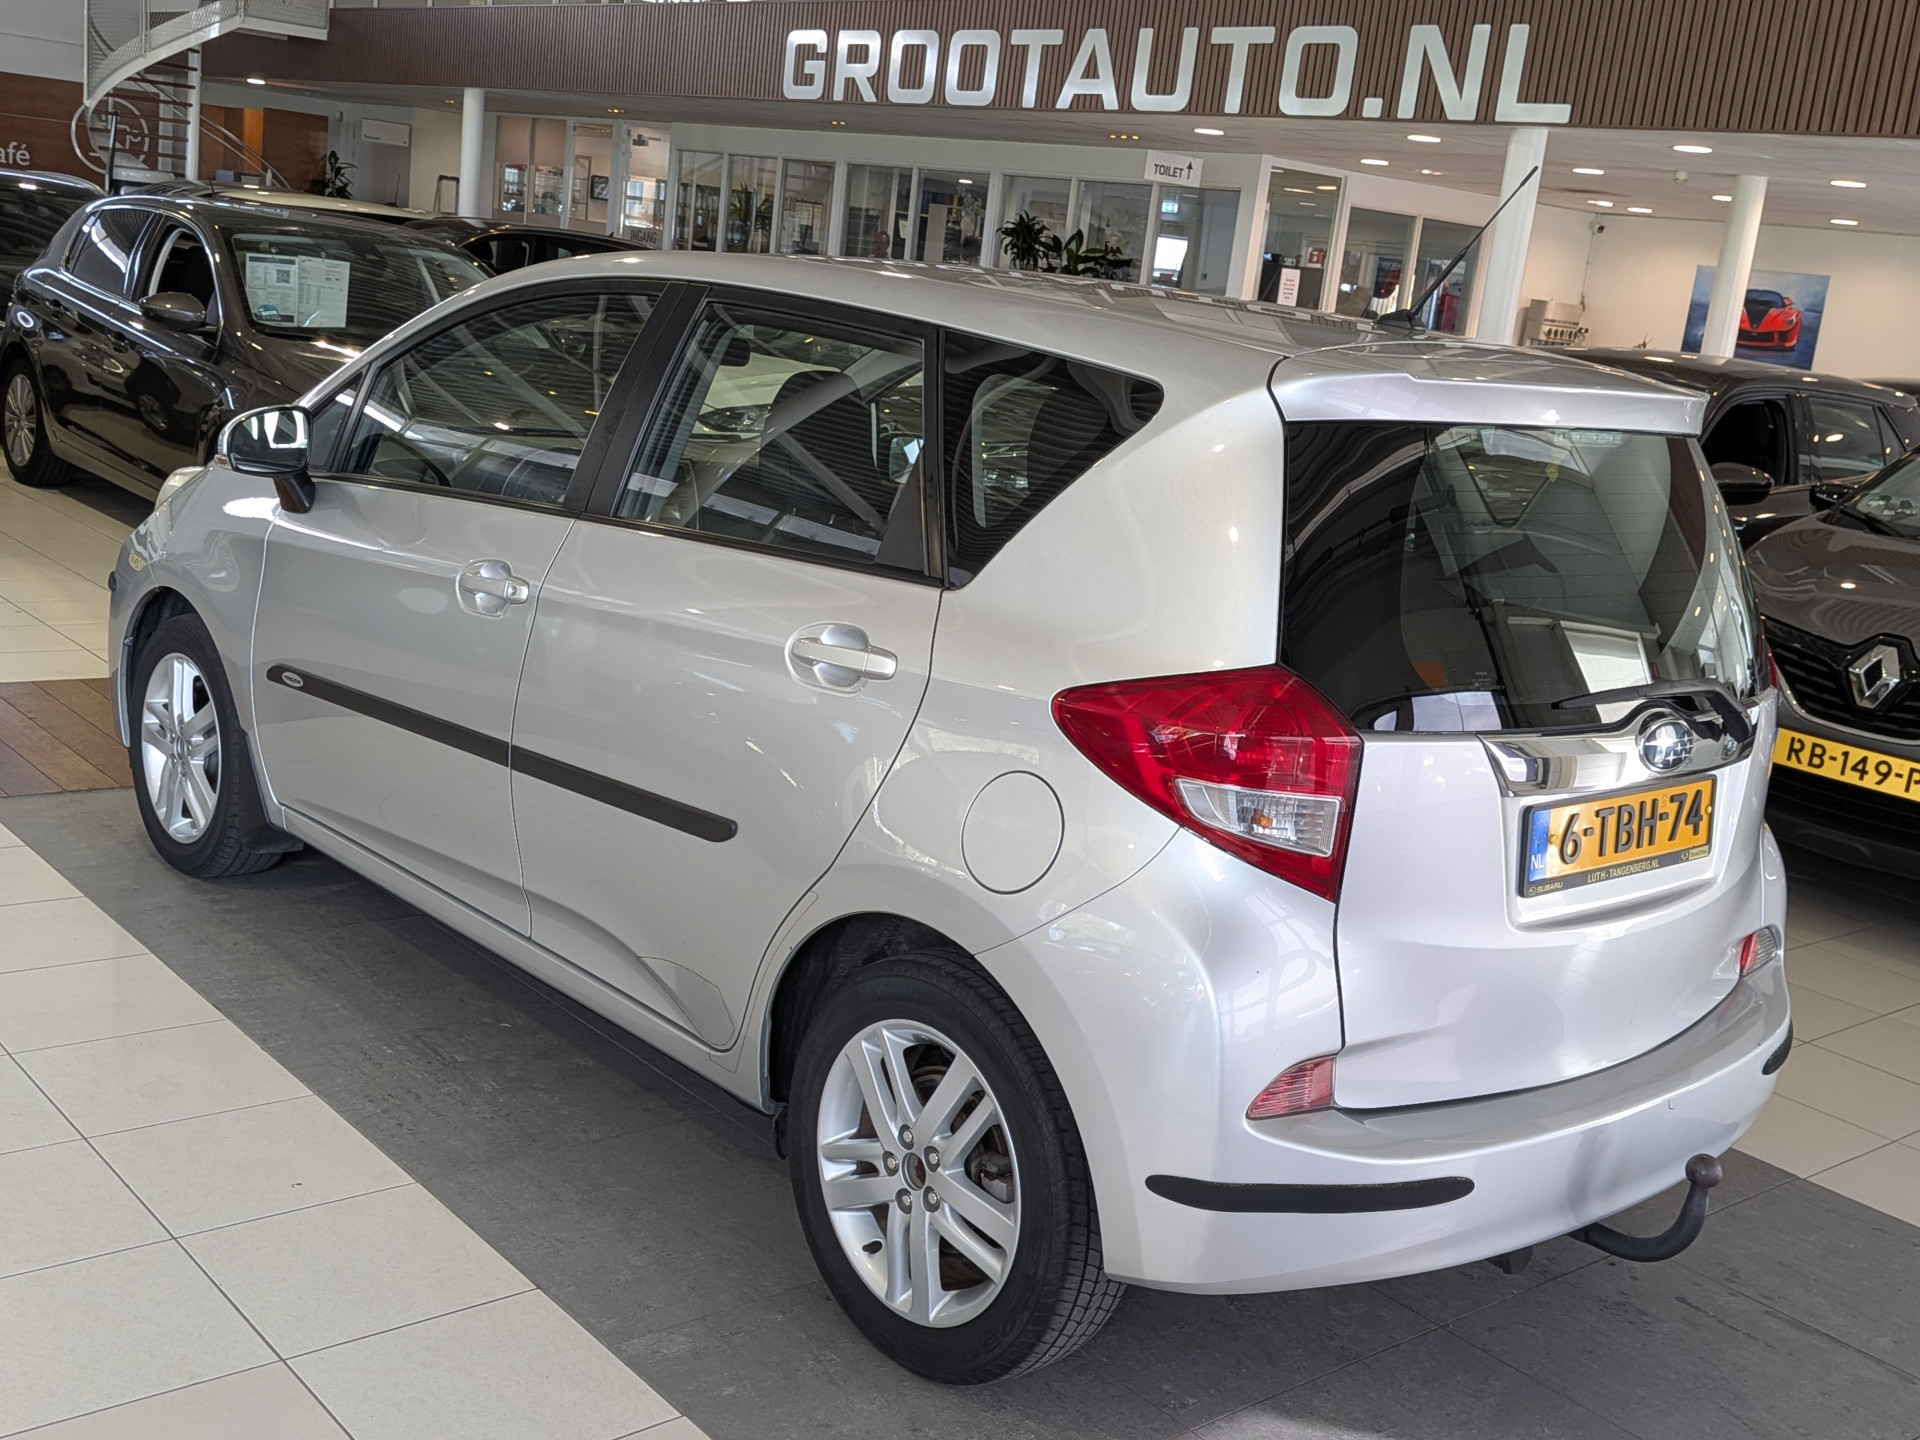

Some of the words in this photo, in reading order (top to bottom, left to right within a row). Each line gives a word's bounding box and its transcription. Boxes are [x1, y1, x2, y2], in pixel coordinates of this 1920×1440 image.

[783, 23, 1571, 124] GROOTAUTO.NL
[1153, 163, 1184, 179] TOILET
[631, 229, 657, 244] INGANG
[1560, 789, 1703, 864] 6-TBH-74
[1531, 854, 1544, 870] NL
[1537, 882, 1563, 893] SUBARU
